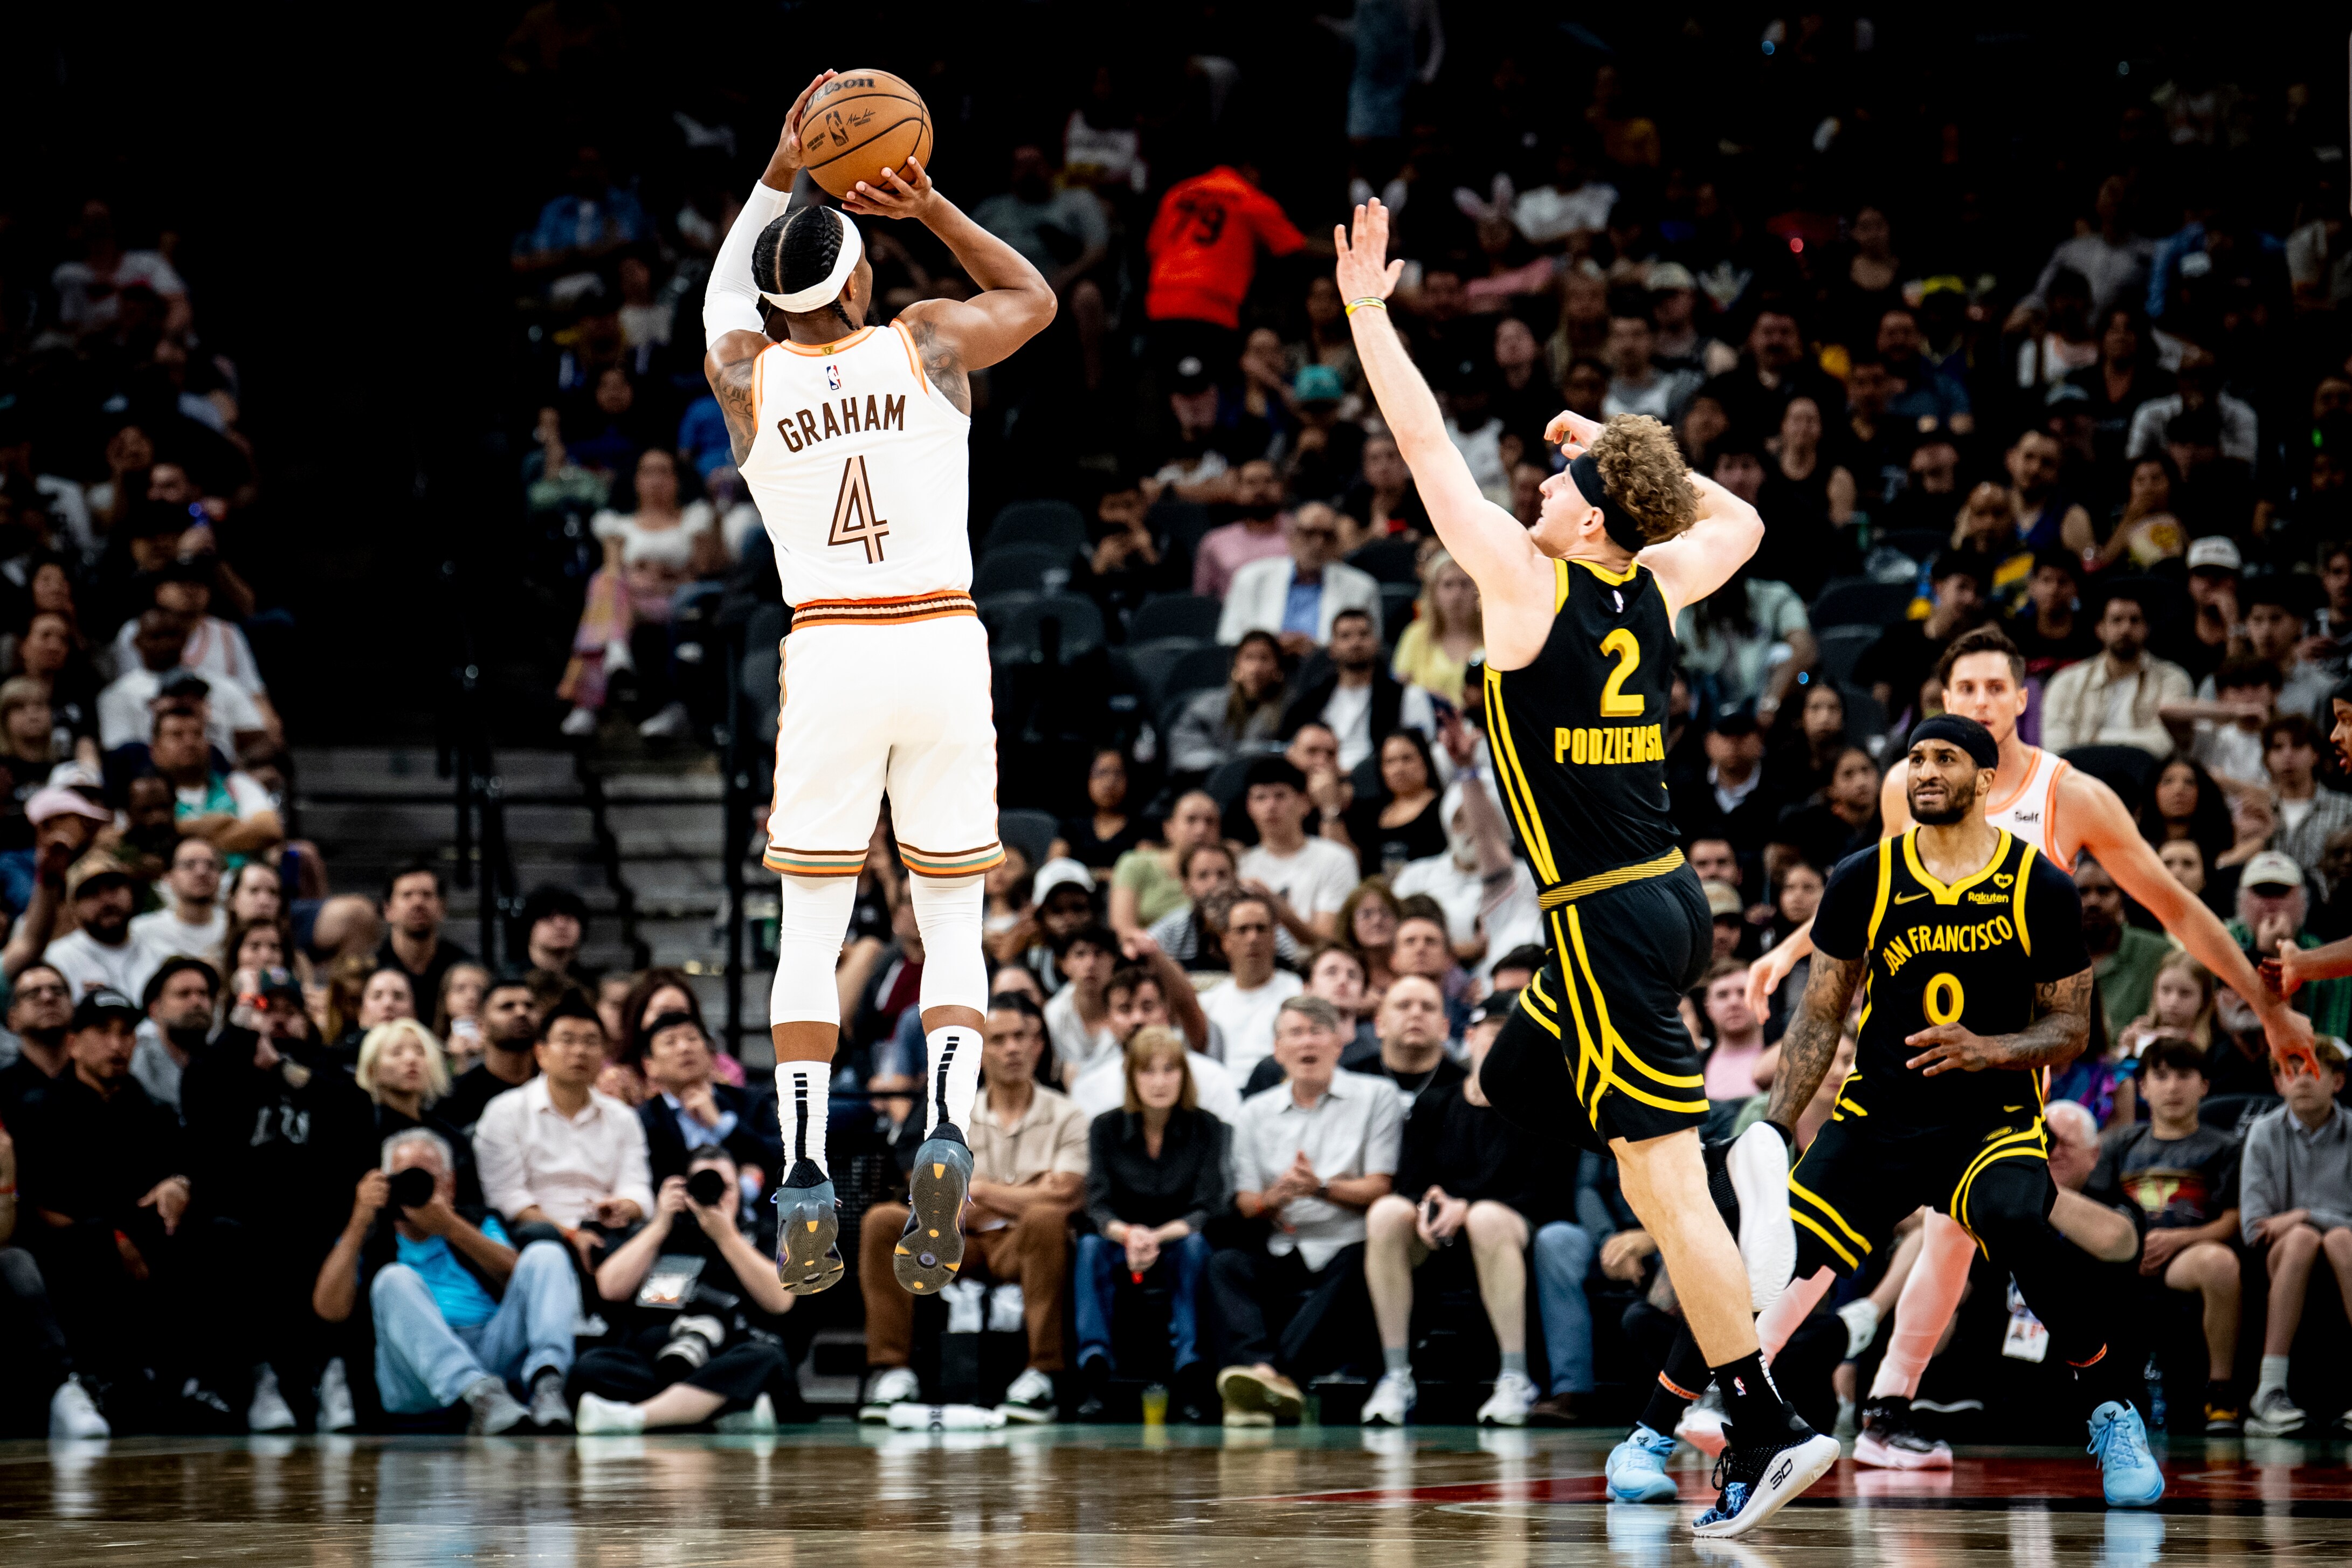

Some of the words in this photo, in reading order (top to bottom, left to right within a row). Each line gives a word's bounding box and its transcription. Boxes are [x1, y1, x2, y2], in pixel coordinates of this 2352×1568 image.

[777, 394, 906, 453] GRAHAM
[827, 455, 889, 564] 4
[1599, 628, 1645, 717] 2
[1968, 891, 2009, 904] Rakuten
[1907, 915, 2013, 954] FRANCISCO
[1922, 972, 1964, 1027] 0
